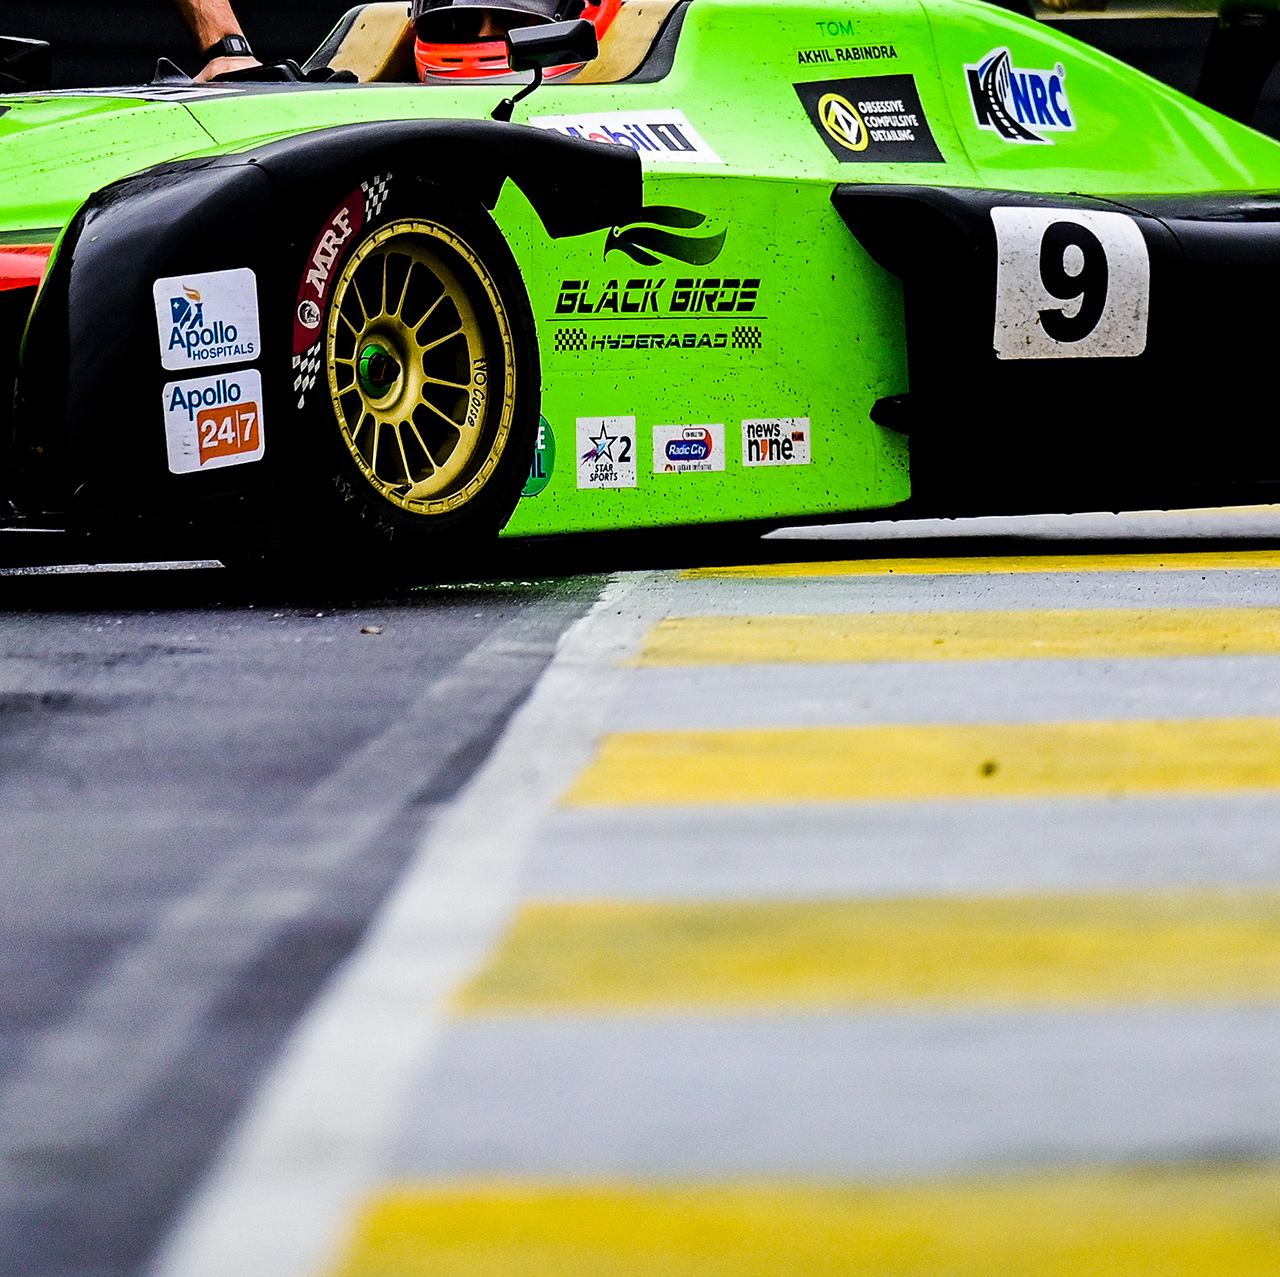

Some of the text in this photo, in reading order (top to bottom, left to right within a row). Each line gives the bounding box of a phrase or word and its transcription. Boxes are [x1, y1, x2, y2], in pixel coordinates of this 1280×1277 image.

[815, 20, 854, 37] TOM
[797, 45, 898, 64] AKHIL RABINDRA
[858, 100, 905, 114] OBSESSIVE
[863, 114, 919, 128] COMPULSIVE
[870, 129, 915, 142] DETAILING
[305, 206, 353, 298] MRF
[1037, 221, 1109, 343] 9
[554, 278, 667, 313] BLACK
[168, 320, 238, 359] Apollo
[590, 332, 728, 350] HYDERABAD
[192, 342, 255, 361] HOSPITALS
[169, 379, 242, 422] Apollo
[747, 423, 781, 439] news
[617, 435, 632, 463] 2
[589, 472, 618, 482] SPORTS
[595, 463, 614, 473] STAR
